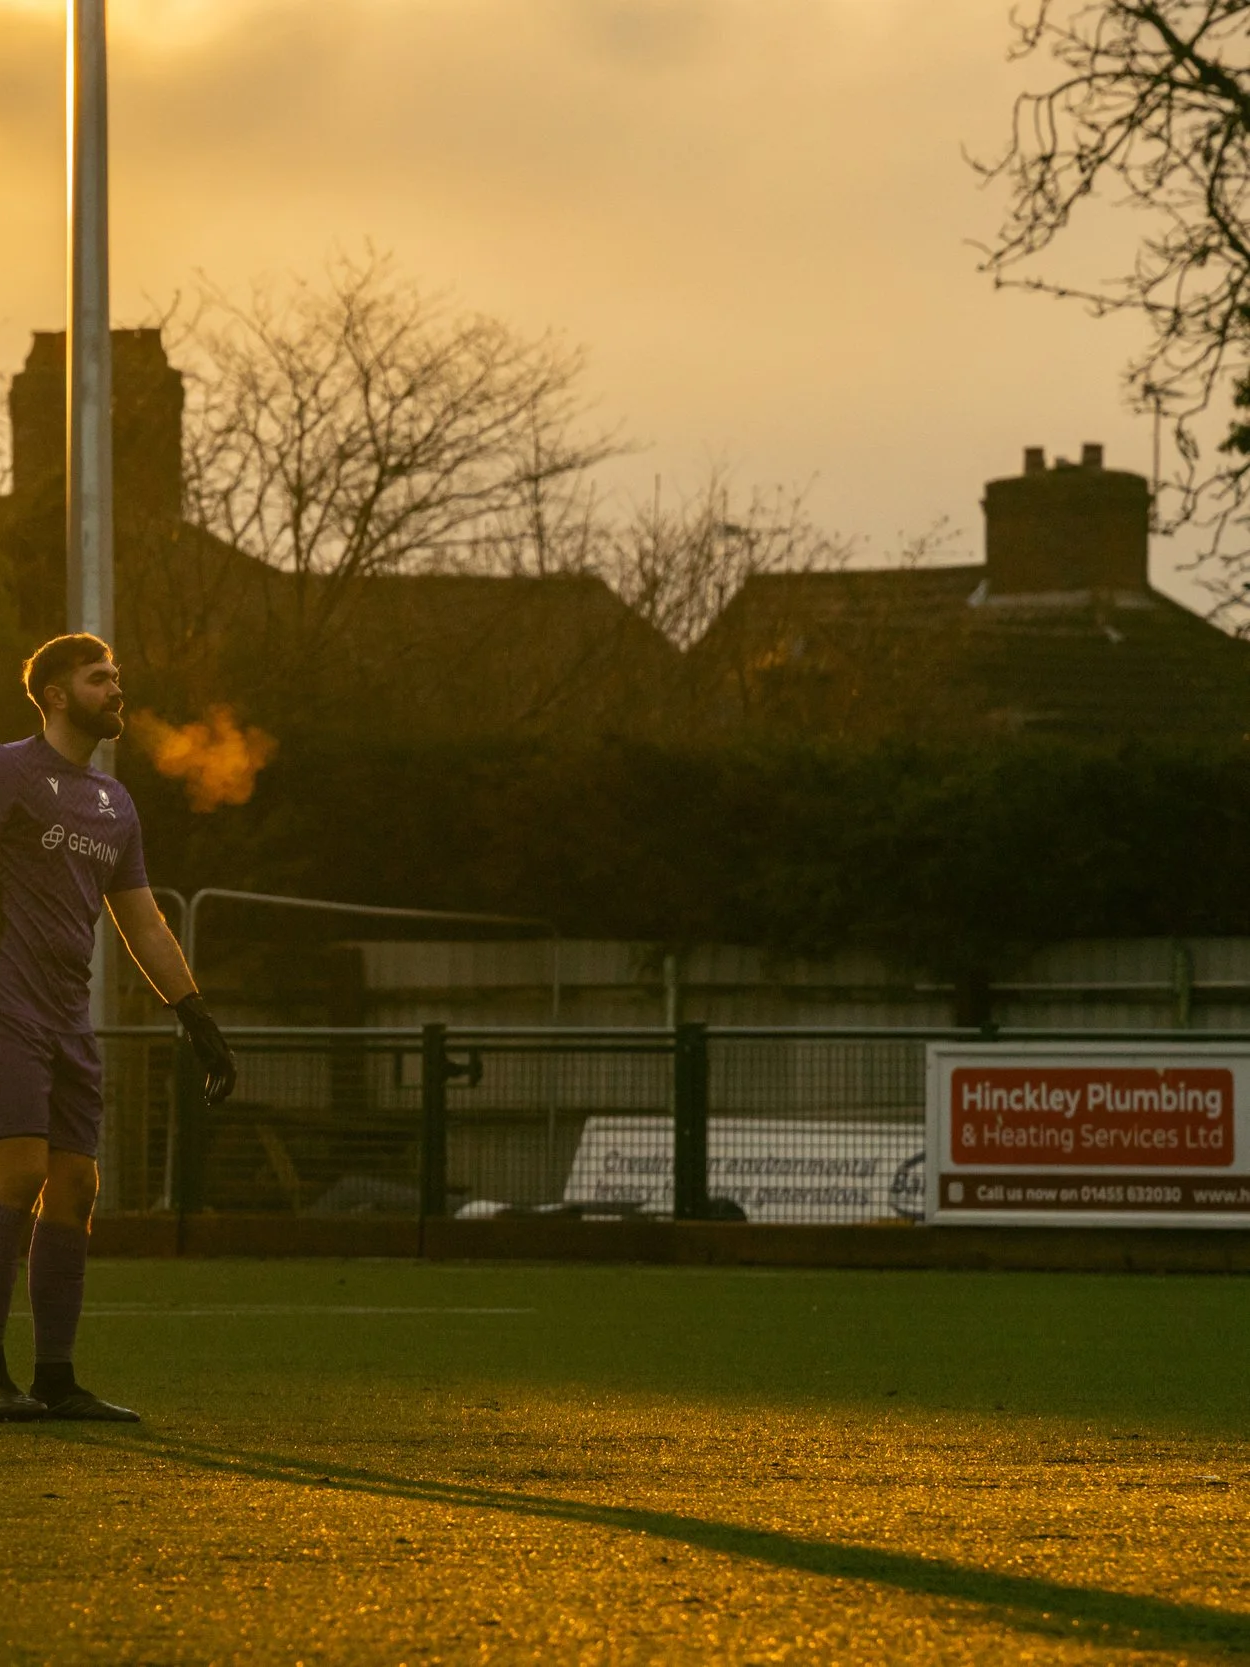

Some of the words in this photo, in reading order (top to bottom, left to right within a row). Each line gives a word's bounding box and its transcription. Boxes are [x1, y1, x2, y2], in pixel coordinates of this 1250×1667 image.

[68, 832, 119, 867] GEMINI
[961, 1082, 1082, 1119] Hinckley
[1086, 1082, 1223, 1120] Plumbing
[960, 1123, 977, 1148] &
[983, 1123, 1075, 1154] Heating
[1080, 1123, 1179, 1150] Services
[1185, 1124, 1224, 1149] Ltd
[976, 1184, 1005, 1202] Call
[1006, 1188, 1024, 1202] us
[1025, 1188, 1058, 1202] now
[1059, 1188, 1079, 1203] on
